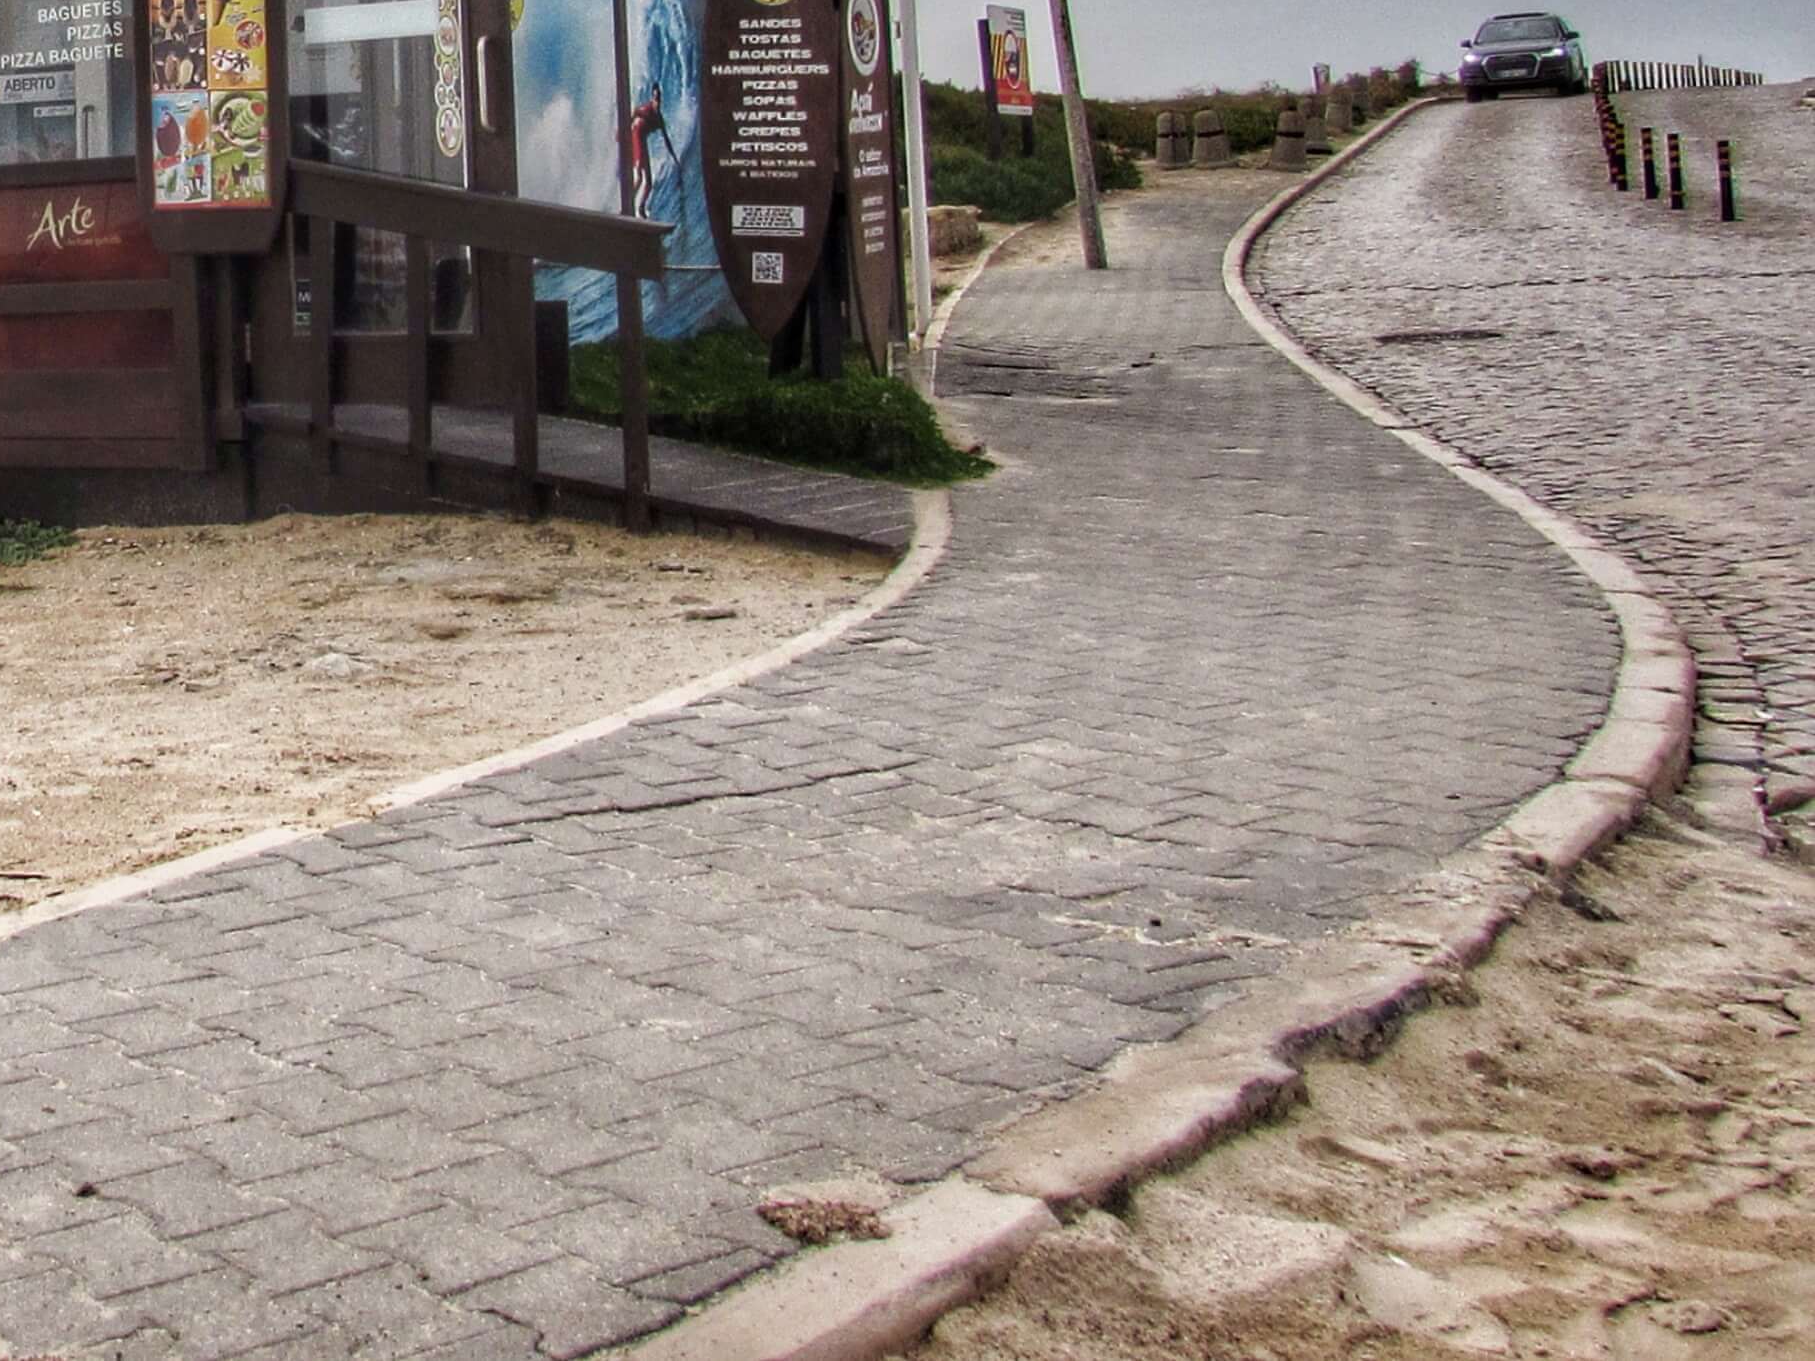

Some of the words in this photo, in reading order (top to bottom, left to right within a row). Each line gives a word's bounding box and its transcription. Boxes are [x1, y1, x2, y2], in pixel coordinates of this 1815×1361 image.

[37, 0, 122, 23] BAGUETES
[739, 19, 802, 29] SANDES
[67, 21, 123, 41] PIZZAS
[739, 34, 801, 44] TOSTAS
[1, 51, 45, 69] PIZZA
[49, 43, 124, 64] BAGUETE
[729, 49, 812, 60] BAGUETES
[711, 64, 830, 75] HAMBURGUERS
[4, 76, 55, 93] ABERTO
[742, 80, 798, 90] PIZZAS
[743, 96, 797, 106] SOPAS
[732, 111, 808, 121] WAFFLES
[738, 127, 801, 136] CREPES
[731, 142, 808, 152] PETISCOS
[26, 195, 96, 251] Arte
